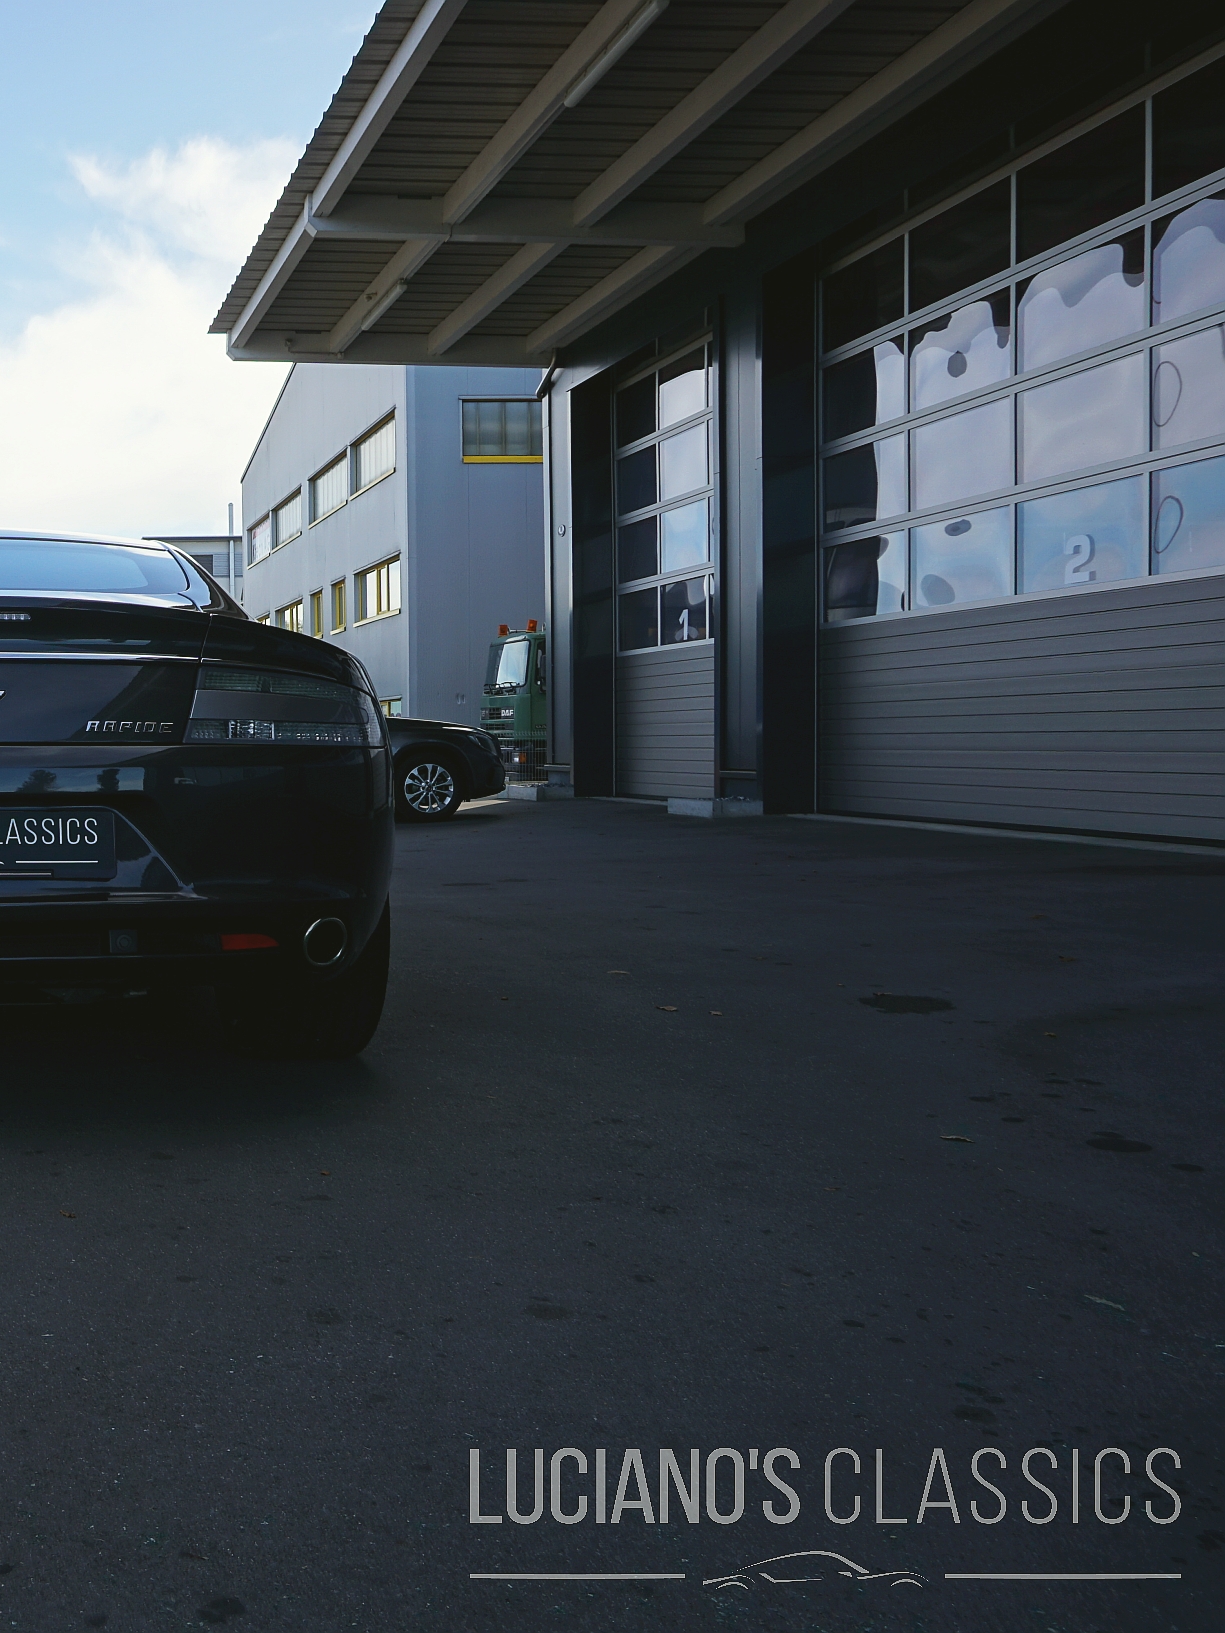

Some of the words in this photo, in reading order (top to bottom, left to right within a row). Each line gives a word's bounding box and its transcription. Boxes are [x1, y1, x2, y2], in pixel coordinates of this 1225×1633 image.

[1064, 534, 1095, 584] 2
[678, 608, 689, 640] 1
[501, 709, 514, 717] DAF
[85, 720, 174, 733] RAPIDE
